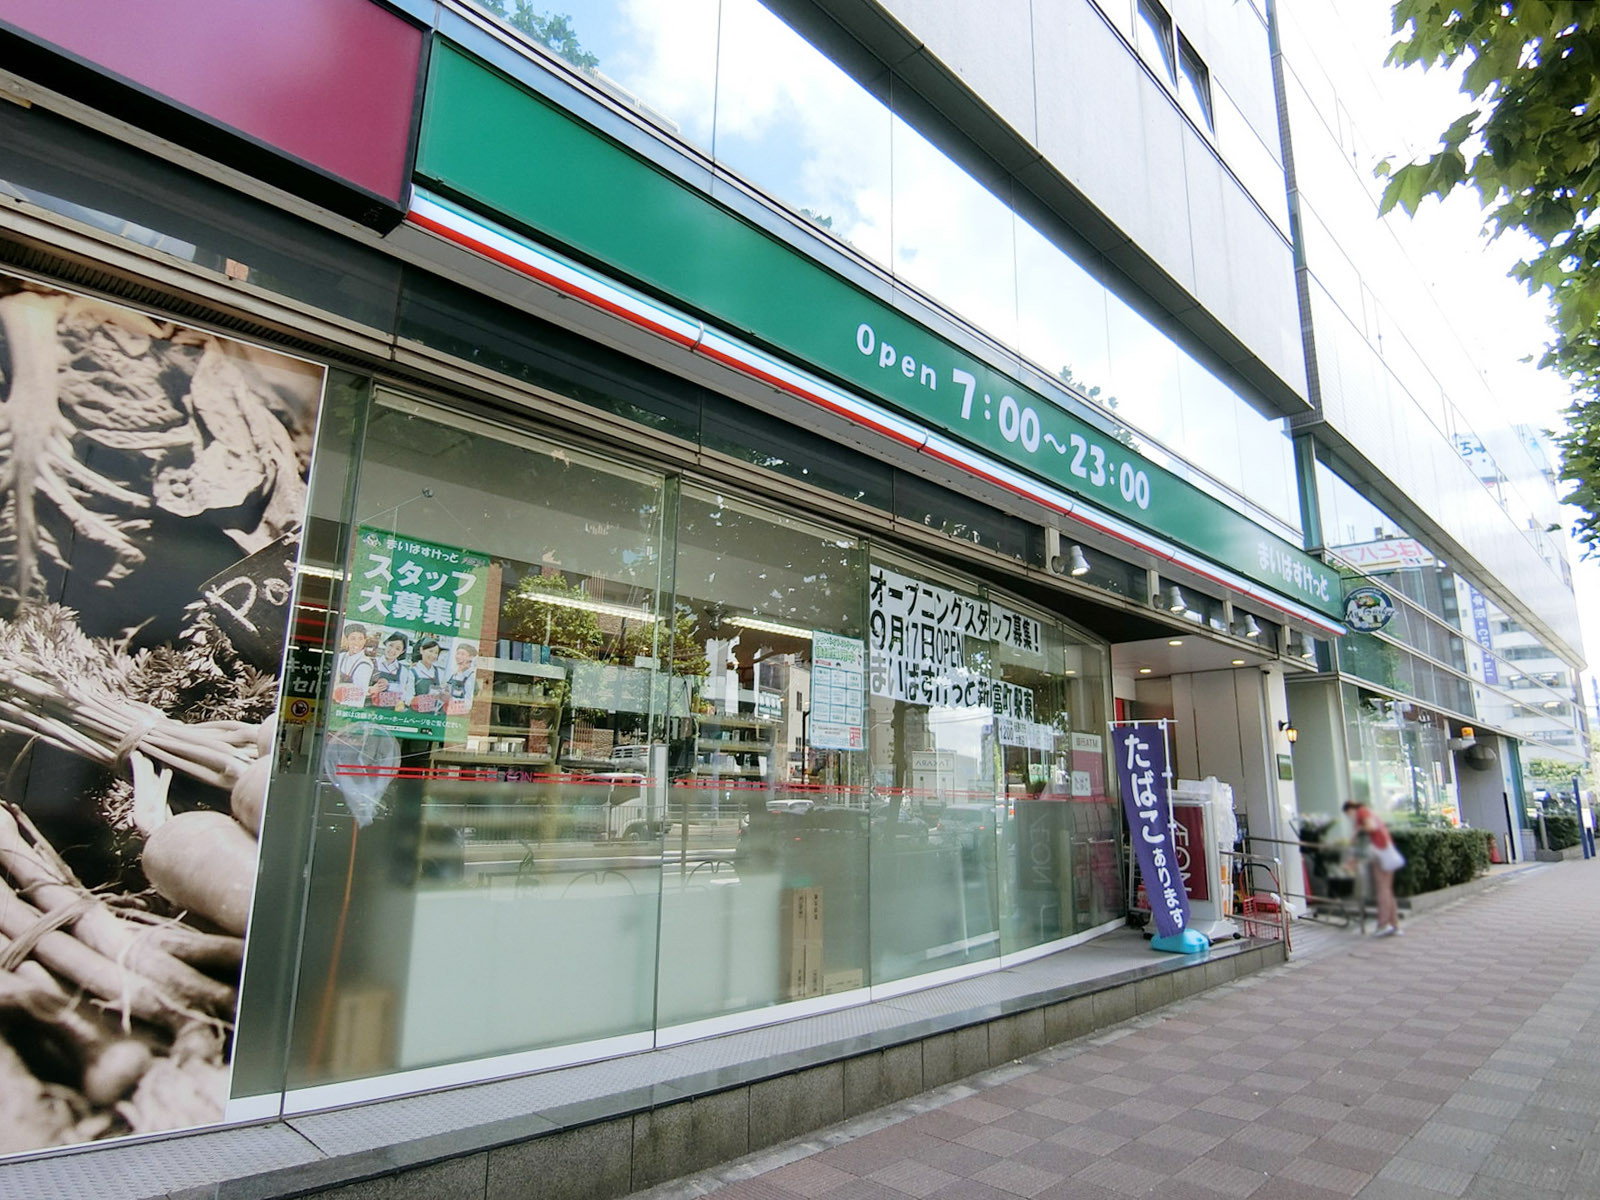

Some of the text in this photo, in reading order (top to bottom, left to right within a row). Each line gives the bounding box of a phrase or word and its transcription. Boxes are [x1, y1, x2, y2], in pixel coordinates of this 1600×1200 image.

[856, 323, 937, 391] Open
[363, 553, 478, 597] スタッフ
[358, 585, 473, 629] 大募集!!
[1124, 734, 1184, 929] たばこ あります
